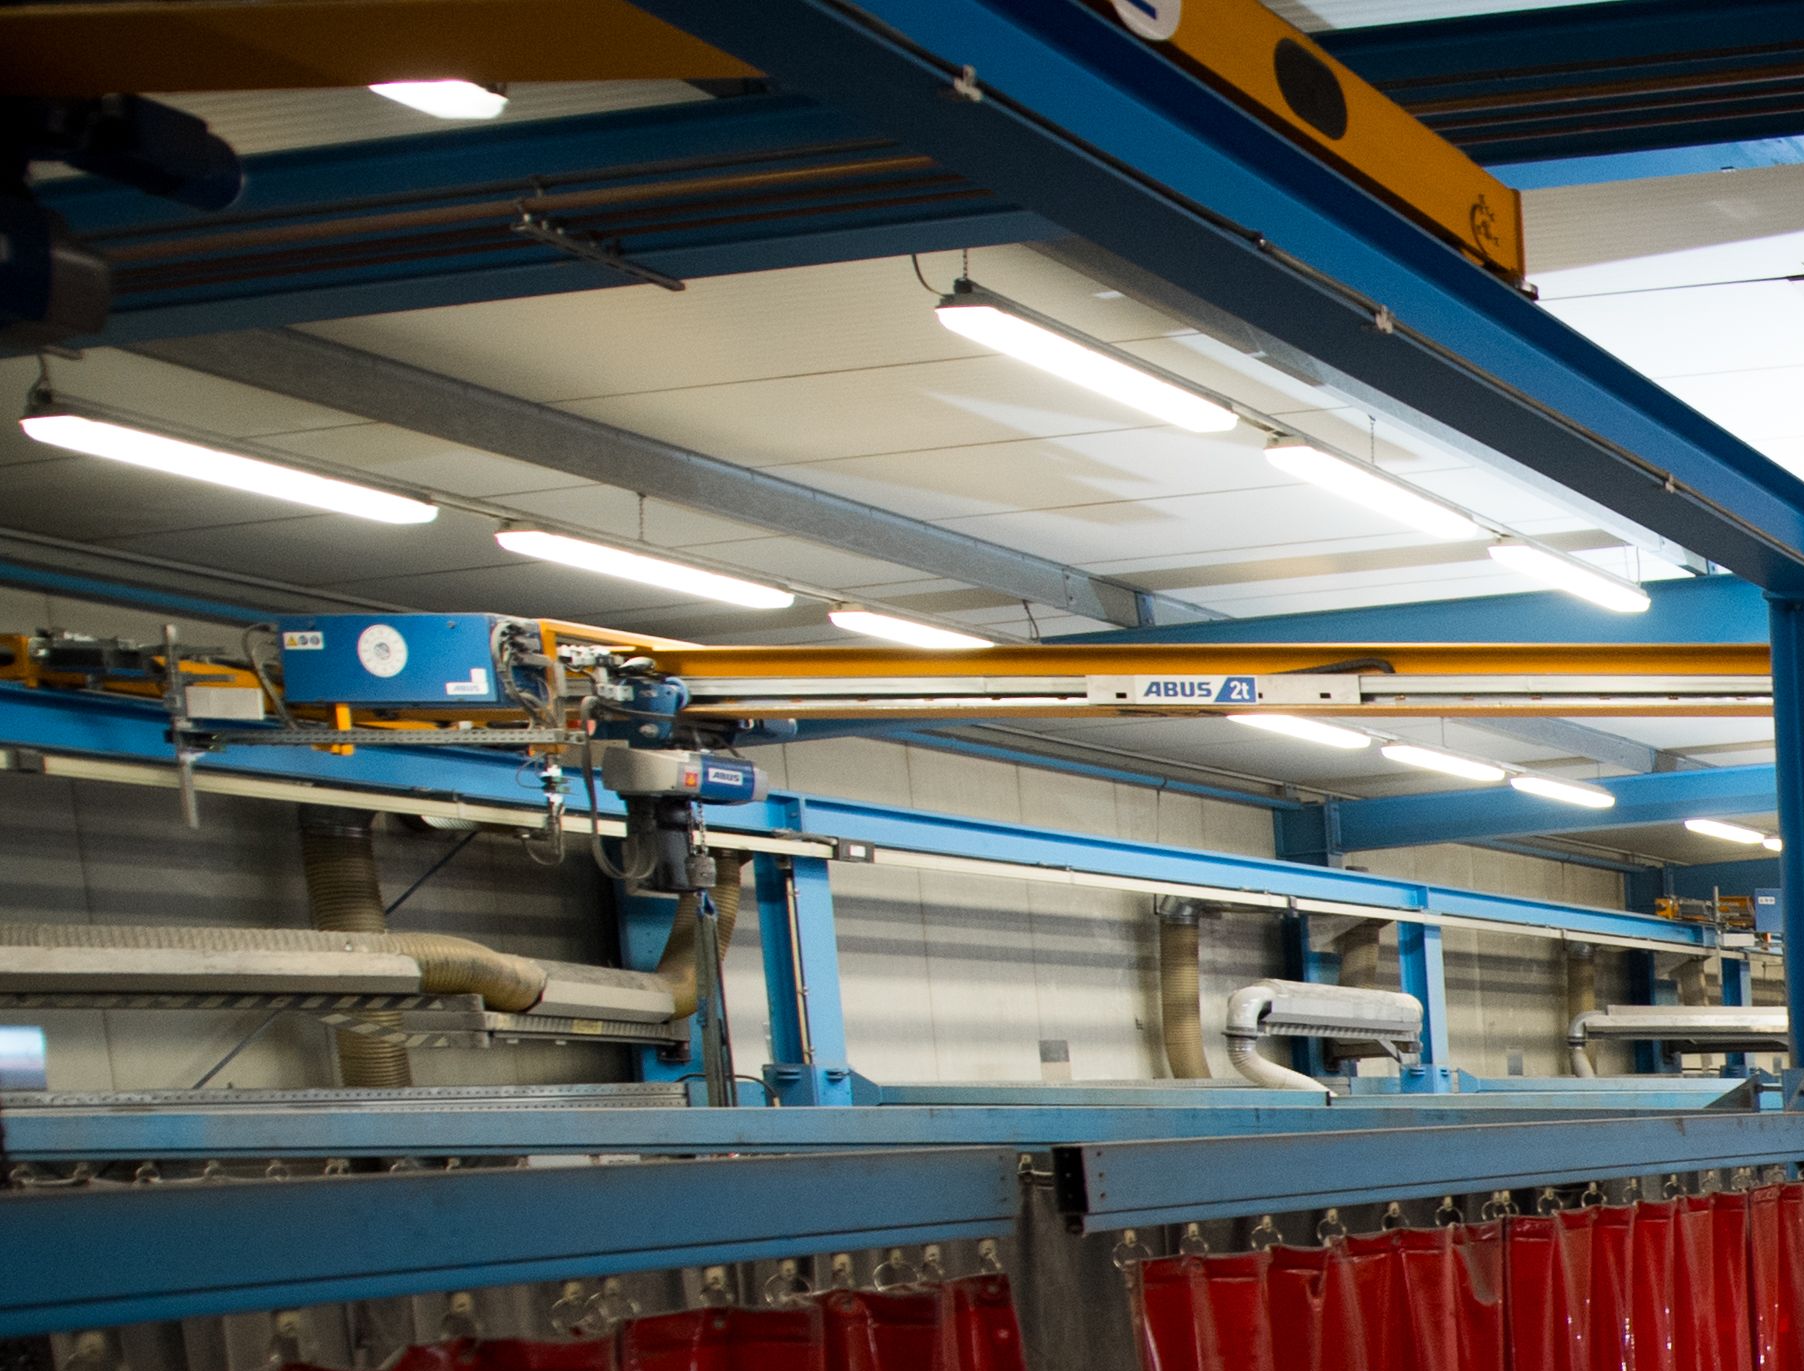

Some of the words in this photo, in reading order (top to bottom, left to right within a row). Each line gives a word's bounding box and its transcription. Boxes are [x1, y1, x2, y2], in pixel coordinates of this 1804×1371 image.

[1143, 681, 1213, 698] ABUS
[1229, 681, 1250, 700] 2t
[711, 770, 740, 783] ABUS
